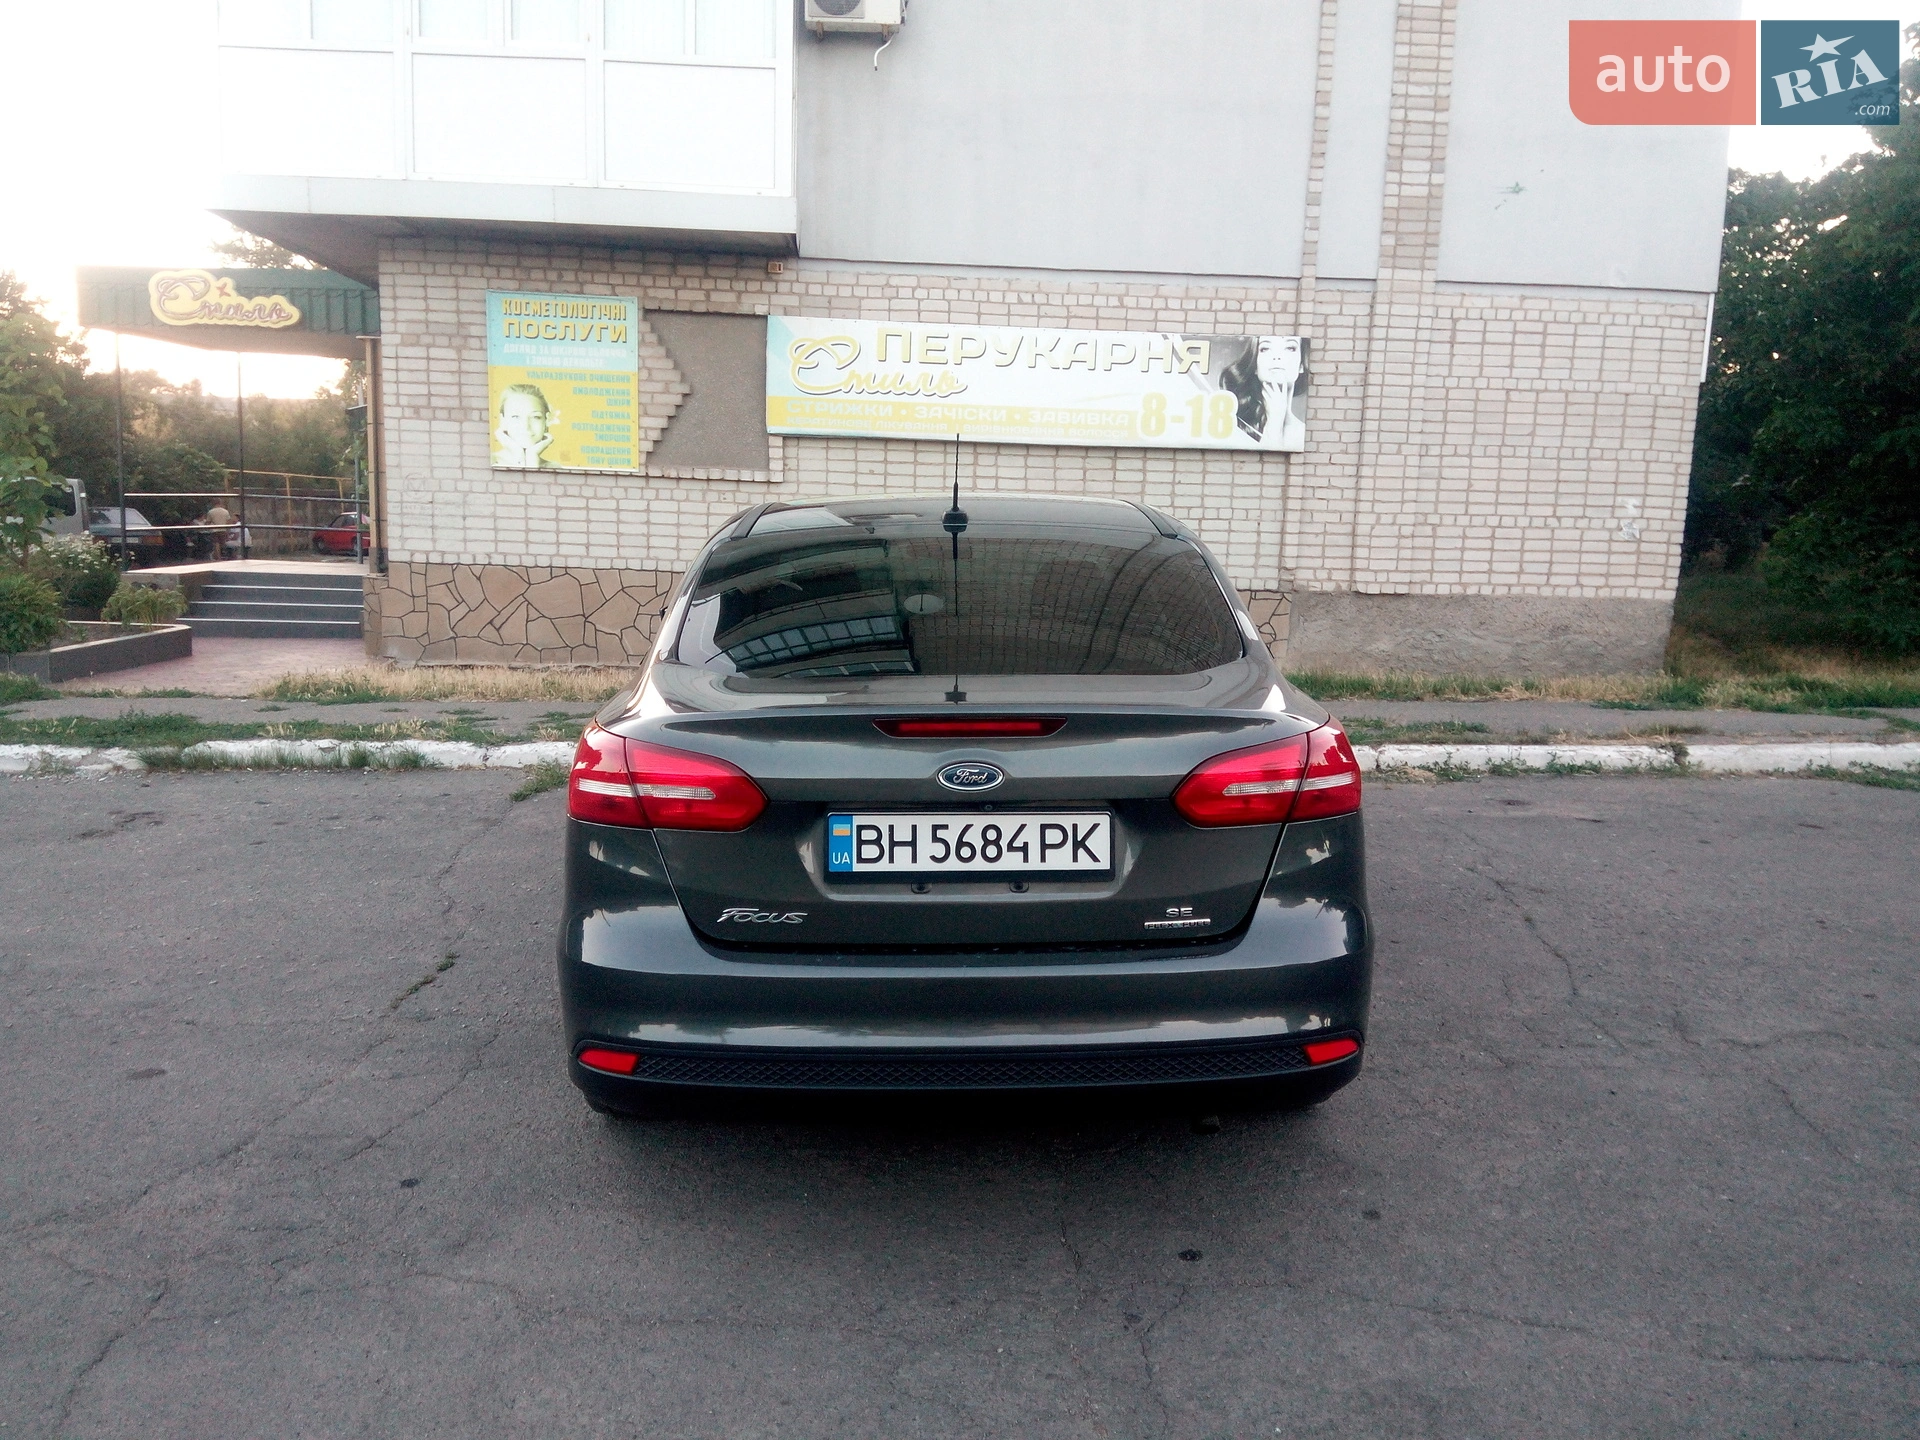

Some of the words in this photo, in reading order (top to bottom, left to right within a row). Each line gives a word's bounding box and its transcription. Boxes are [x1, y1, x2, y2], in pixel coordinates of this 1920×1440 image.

[502, 298, 627, 321] КОСМЕТОЛОГІЧНІ
[503, 319, 628, 344] ПОСЛУГИ
[876, 327, 1212, 376] ПЕРУКАРНЯ
[788, 335, 968, 398] Стиль
[786, 398, 893, 418] СТРИЖКИ
[914, 405, 1007, 423] ЗАЧІСКИ
[1028, 410, 1129, 426] ЗАВИВКА
[1139, 391, 1235, 441] 8-18
[952, 767, 989, 785] Ford
[855, 823, 919, 864] BH
[929, 823, 1029, 864] 5684
[1039, 823, 1102, 864] PK
[832, 852, 851, 865] UA
[1165, 907, 1193, 918] SE
